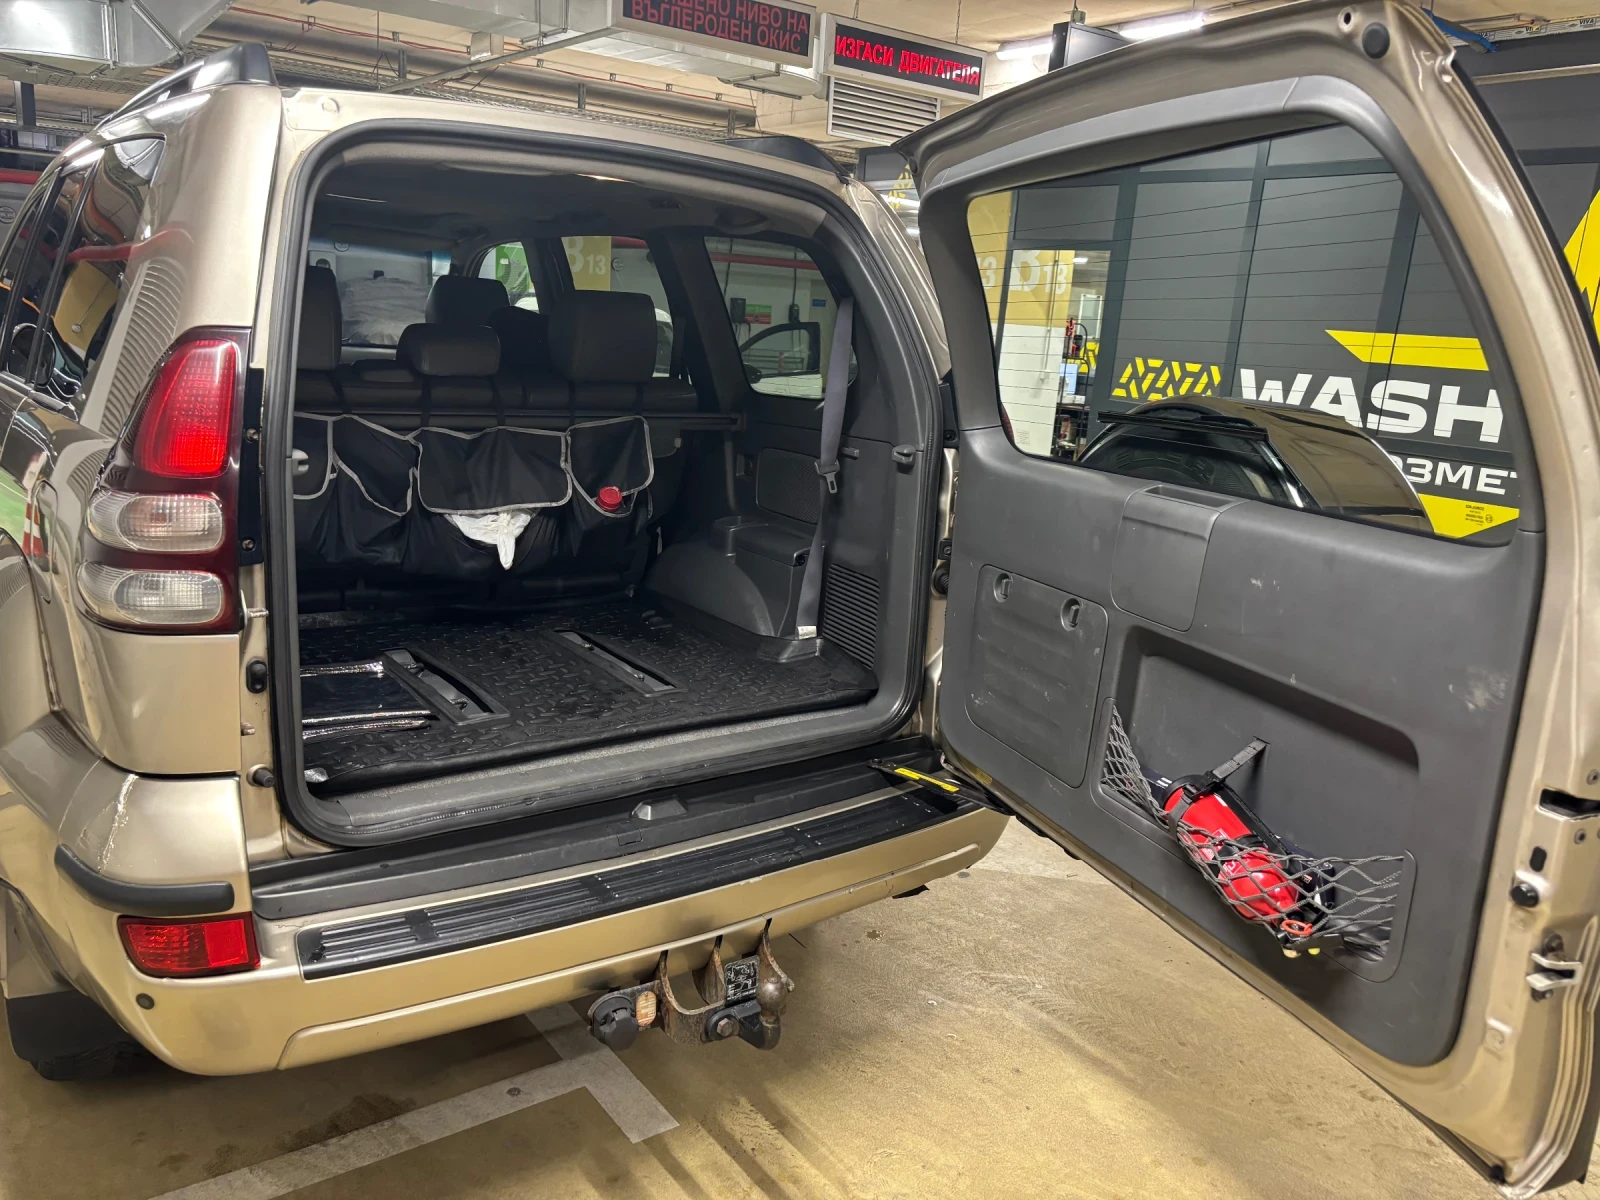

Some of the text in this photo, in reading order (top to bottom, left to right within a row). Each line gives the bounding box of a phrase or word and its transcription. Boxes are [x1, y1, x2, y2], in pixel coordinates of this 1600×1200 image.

[631, 0, 801, 53] ВЪГЛЕРОДЕН ОКИС
[736, 0, 782, 27] НИВО
[787, 10, 809, 34] НА
[835, 35, 980, 86] ИЗГАСИ ДВИГАТЕЛЯ
[1240, 368, 1504, 444] WASH
[1390, 455, 1518, 496] ЗМЕ
